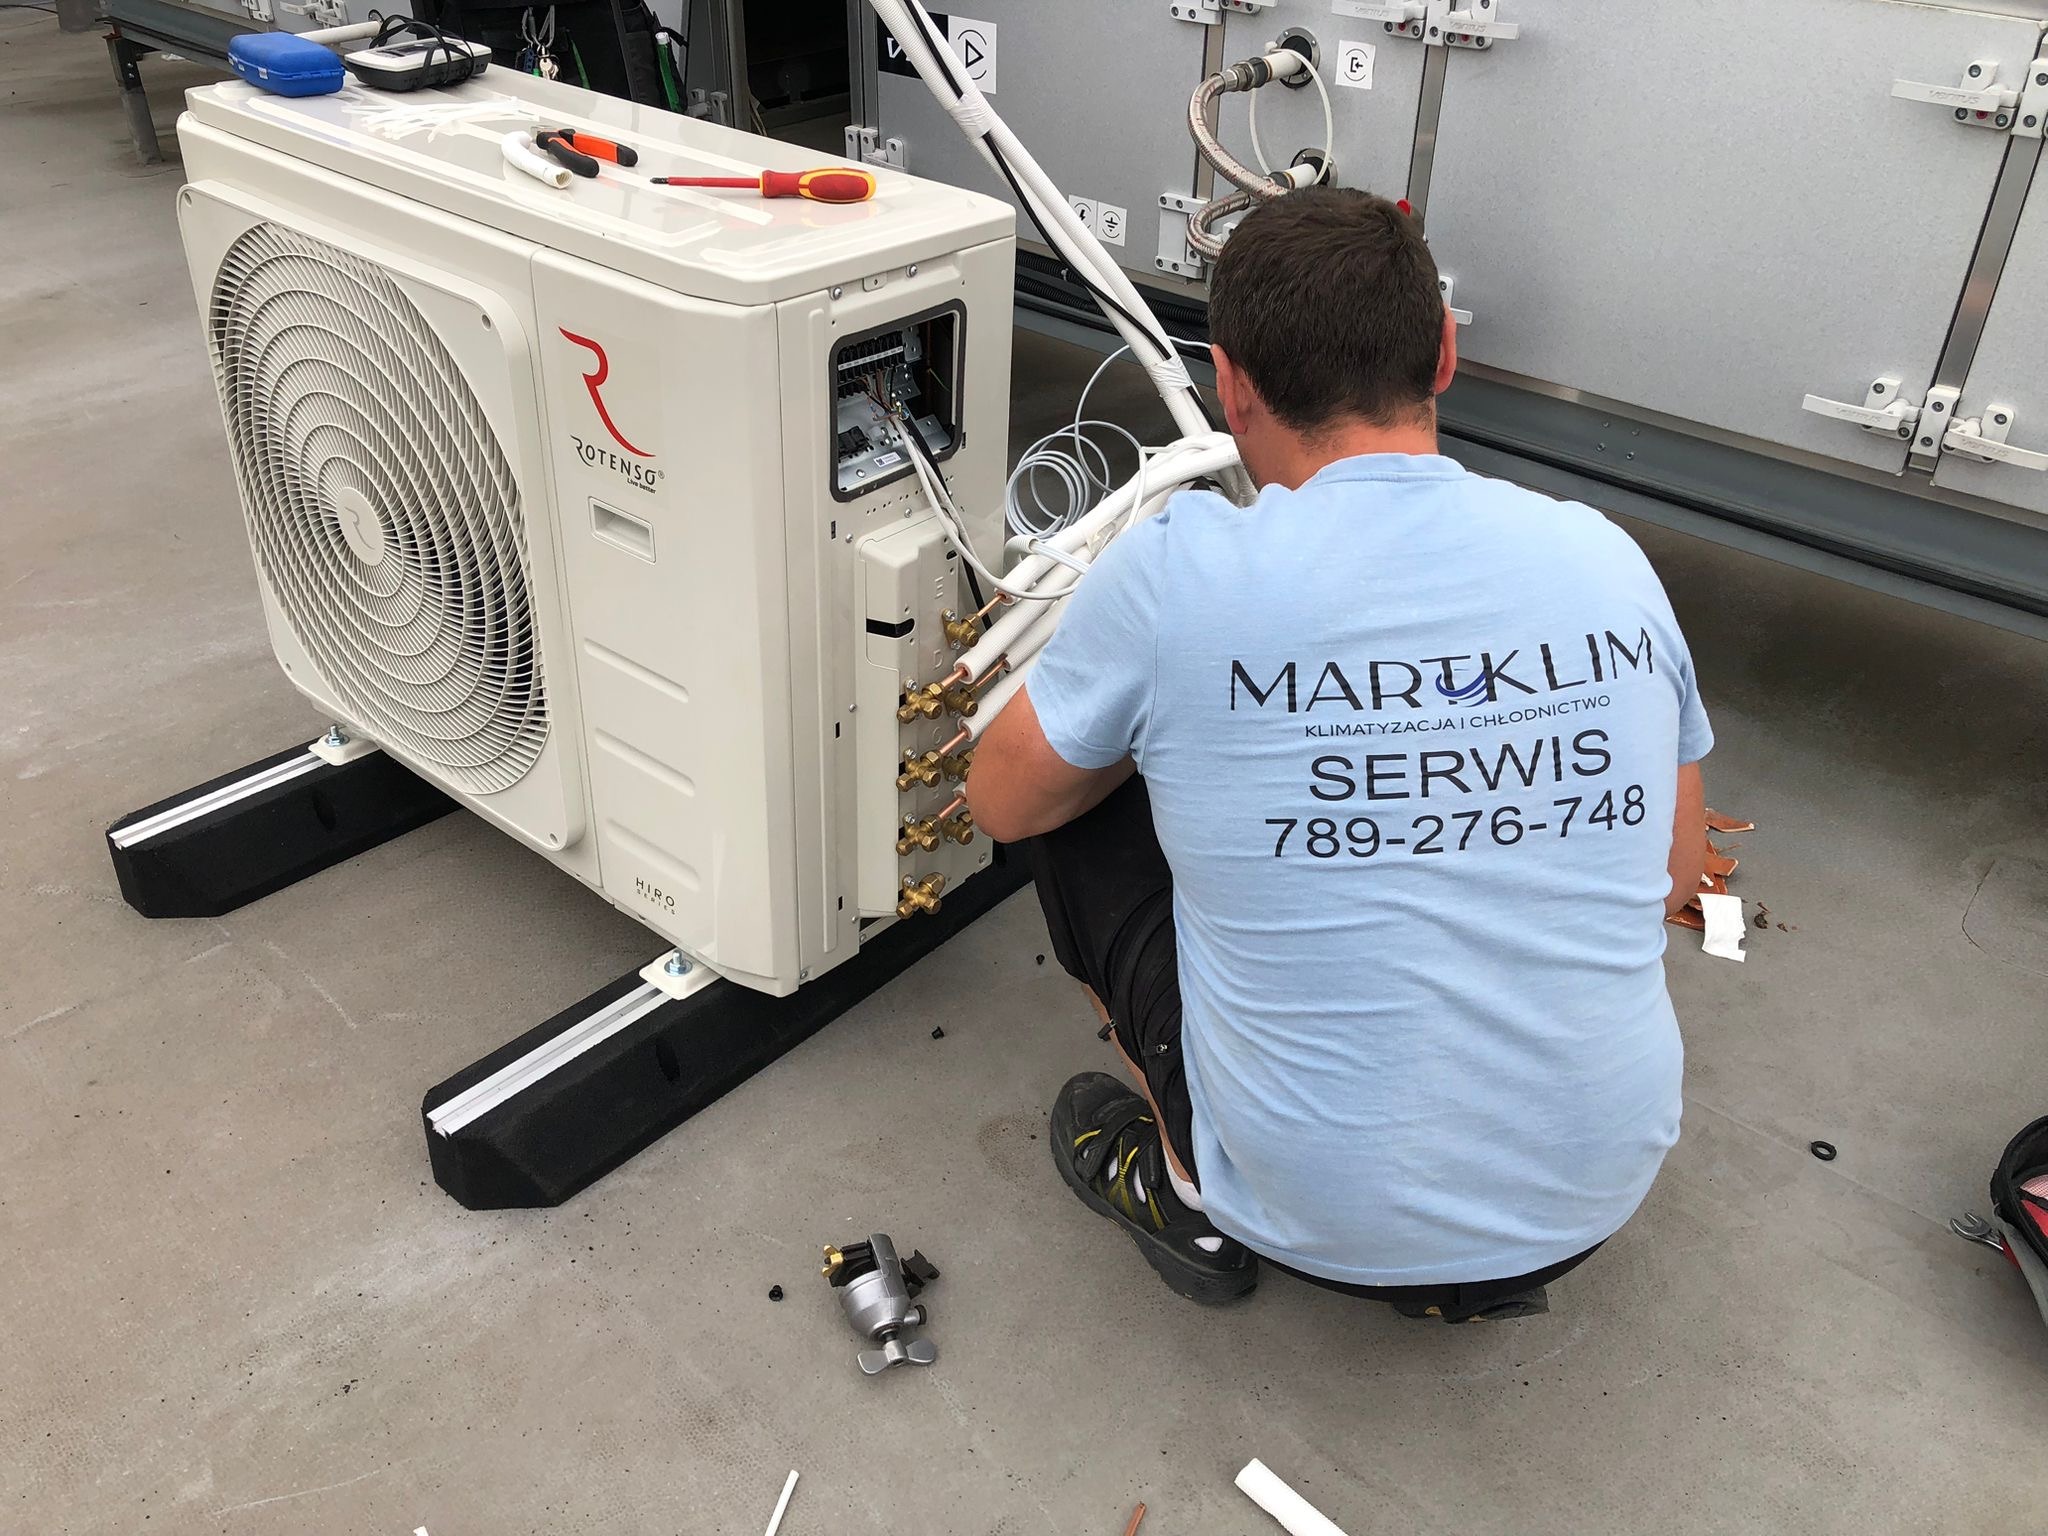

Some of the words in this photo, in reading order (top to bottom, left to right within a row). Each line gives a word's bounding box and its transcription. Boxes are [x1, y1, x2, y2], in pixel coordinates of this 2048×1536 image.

[1304, 718, 1456, 738] KLIMATYZACJA
[1469, 694, 1612, 729] CHŁODNICTWO
[1308, 728, 1612, 801] SERWIS
[1265, 784, 1646, 859] 789-276-748
[636, 877, 675, 907] HIRO
